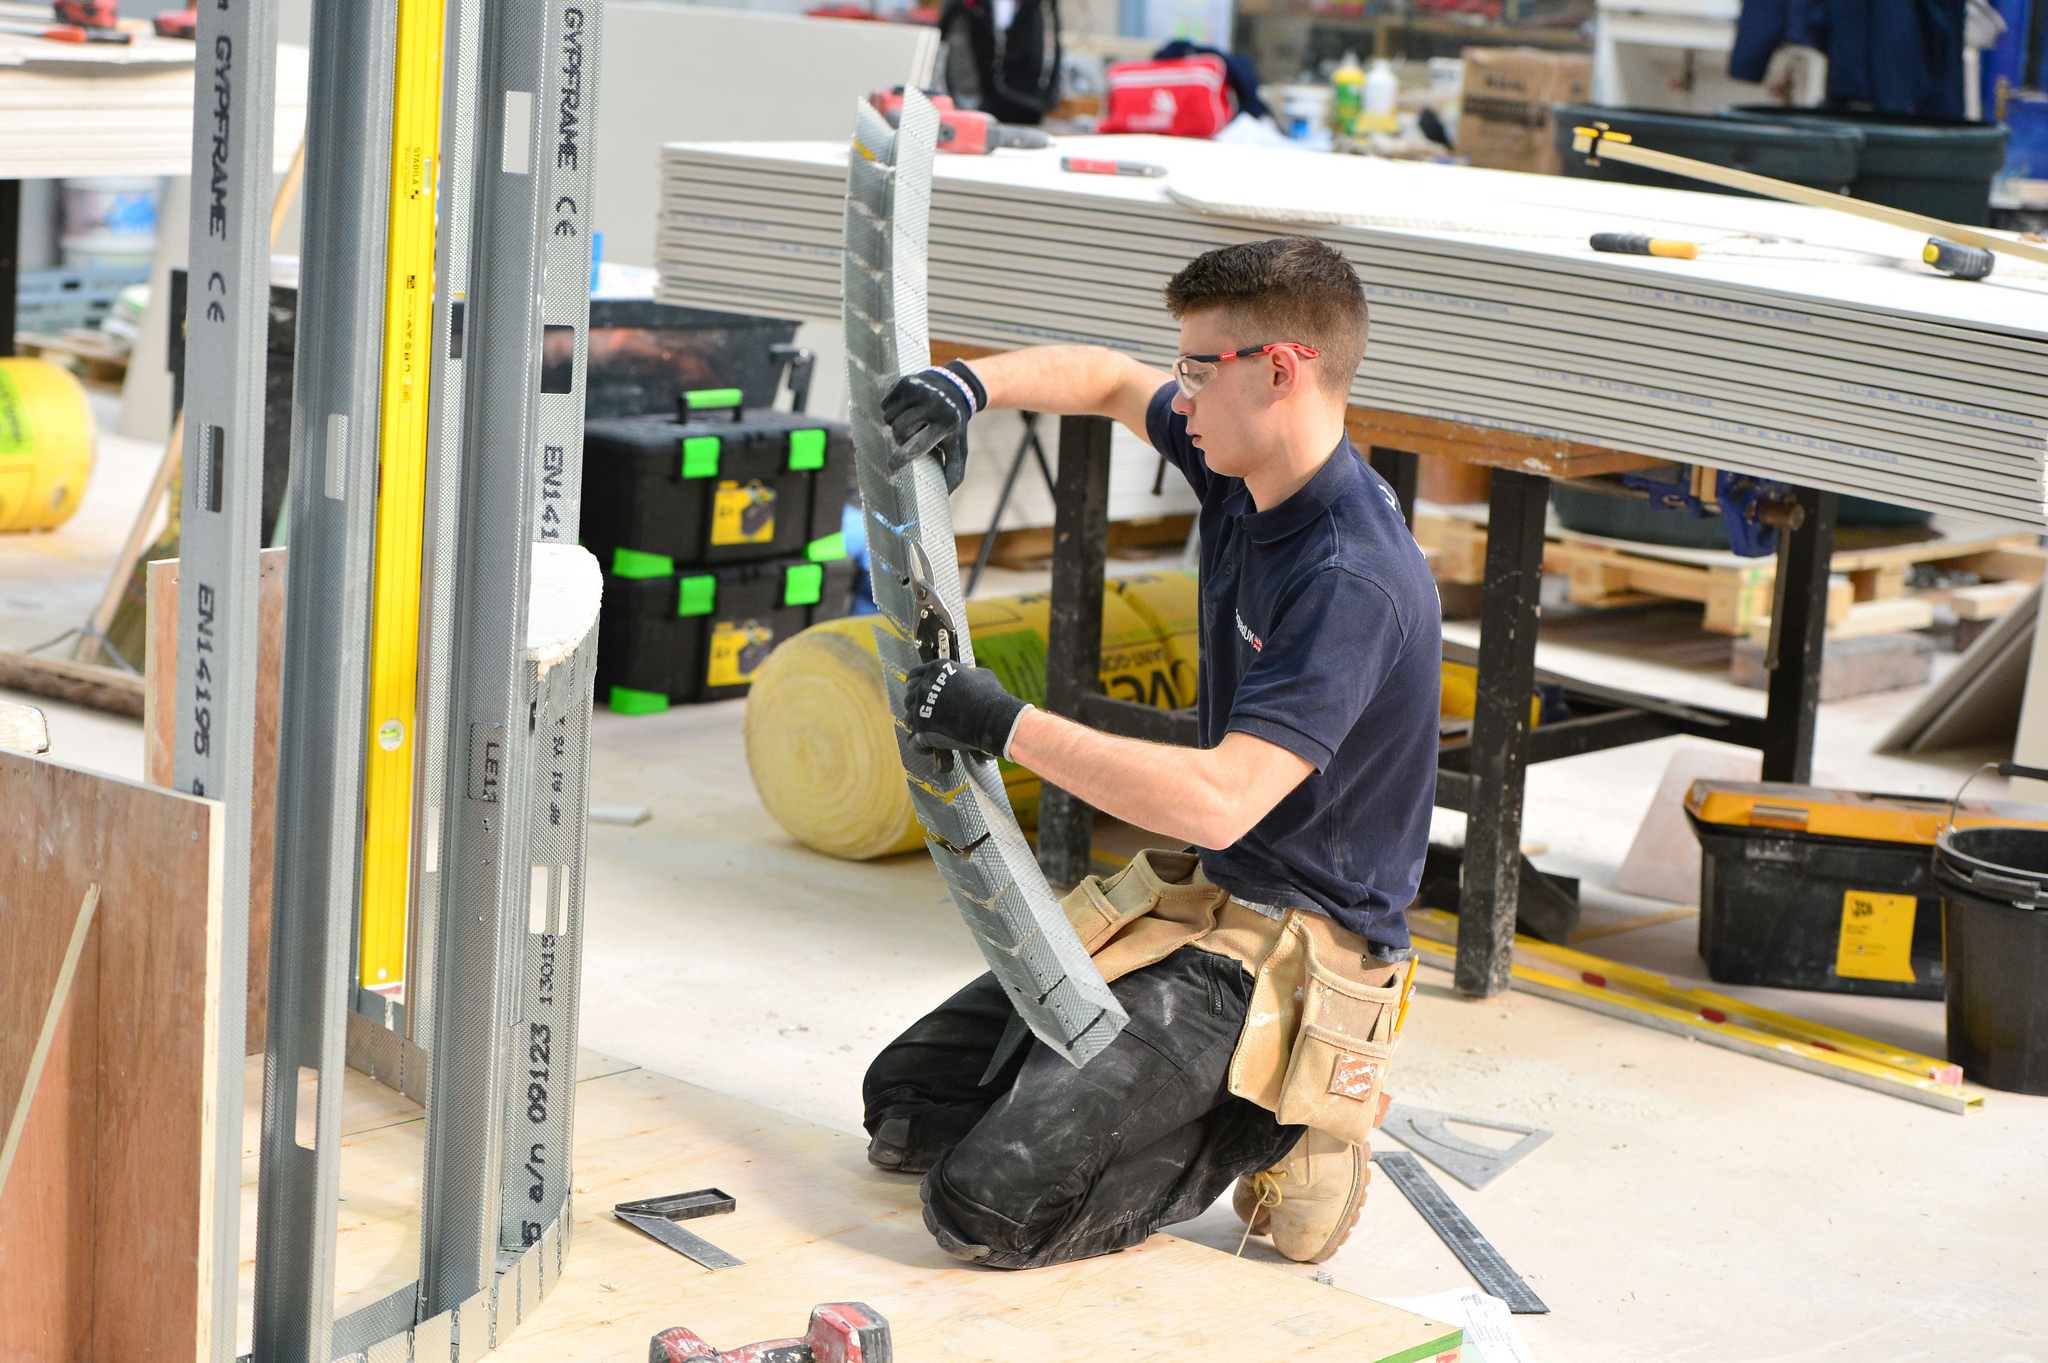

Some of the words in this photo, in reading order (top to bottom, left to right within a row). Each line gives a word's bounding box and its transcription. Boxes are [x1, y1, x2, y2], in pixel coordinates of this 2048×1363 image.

[209, 34, 232, 241] GYPFRAME
[558, 7, 584, 171] GYPFRAME
[412, 147, 421, 185] STABILA
[541, 445, 563, 539] EN141
[194, 582, 215, 758] EN14195
[919, 662, 957, 719] GRIPZ
[527, 1021, 551, 1124] 09123
[525, 1142, 546, 1204] a/n
